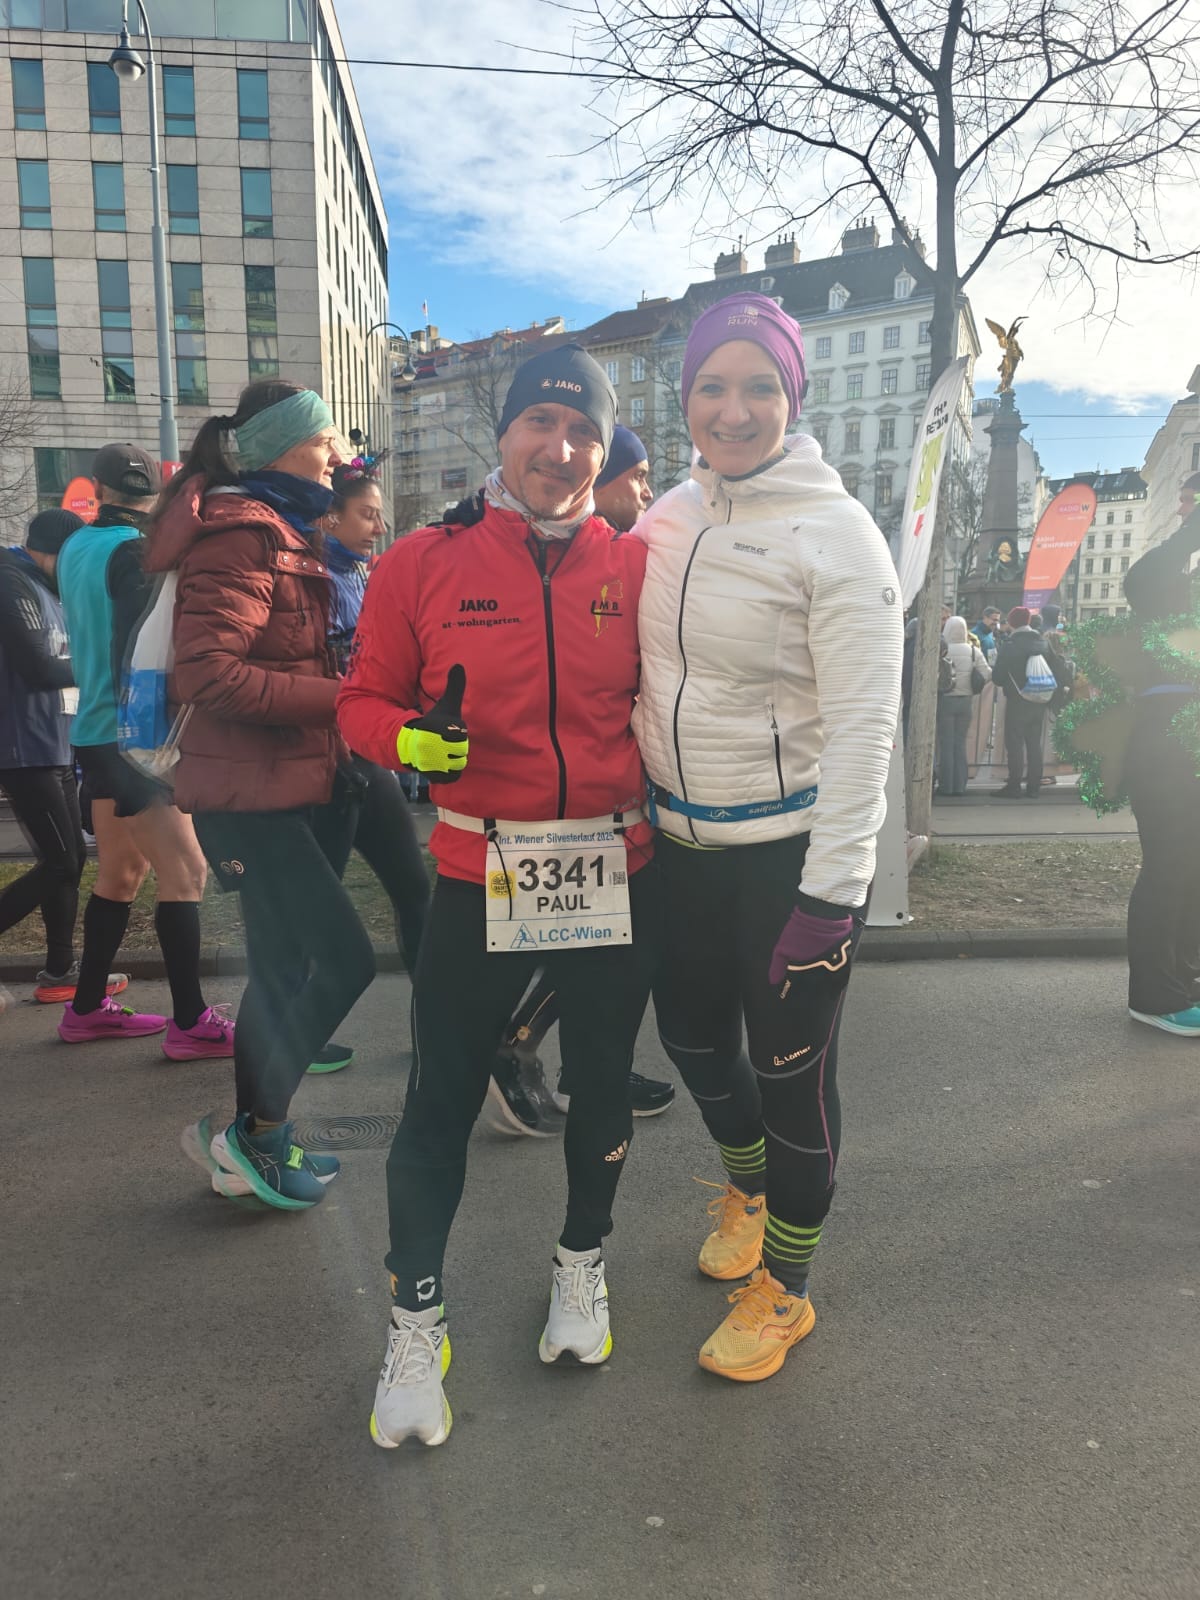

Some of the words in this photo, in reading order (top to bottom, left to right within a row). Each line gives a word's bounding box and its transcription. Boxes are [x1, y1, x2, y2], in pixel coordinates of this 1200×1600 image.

[727, 317, 759, 327] RUN
[554, 379, 582, 393] JAKO
[458, 599, 498, 612] JAKO
[514, 834, 544, 845] Wiener
[546, 832, 595, 844] Silvesterlauf
[596, 831, 615, 842] 2025
[517, 855, 604, 892] 3341
[537, 894, 591, 913] PAUL
[539, 927, 612, 943] LCC-Wien
